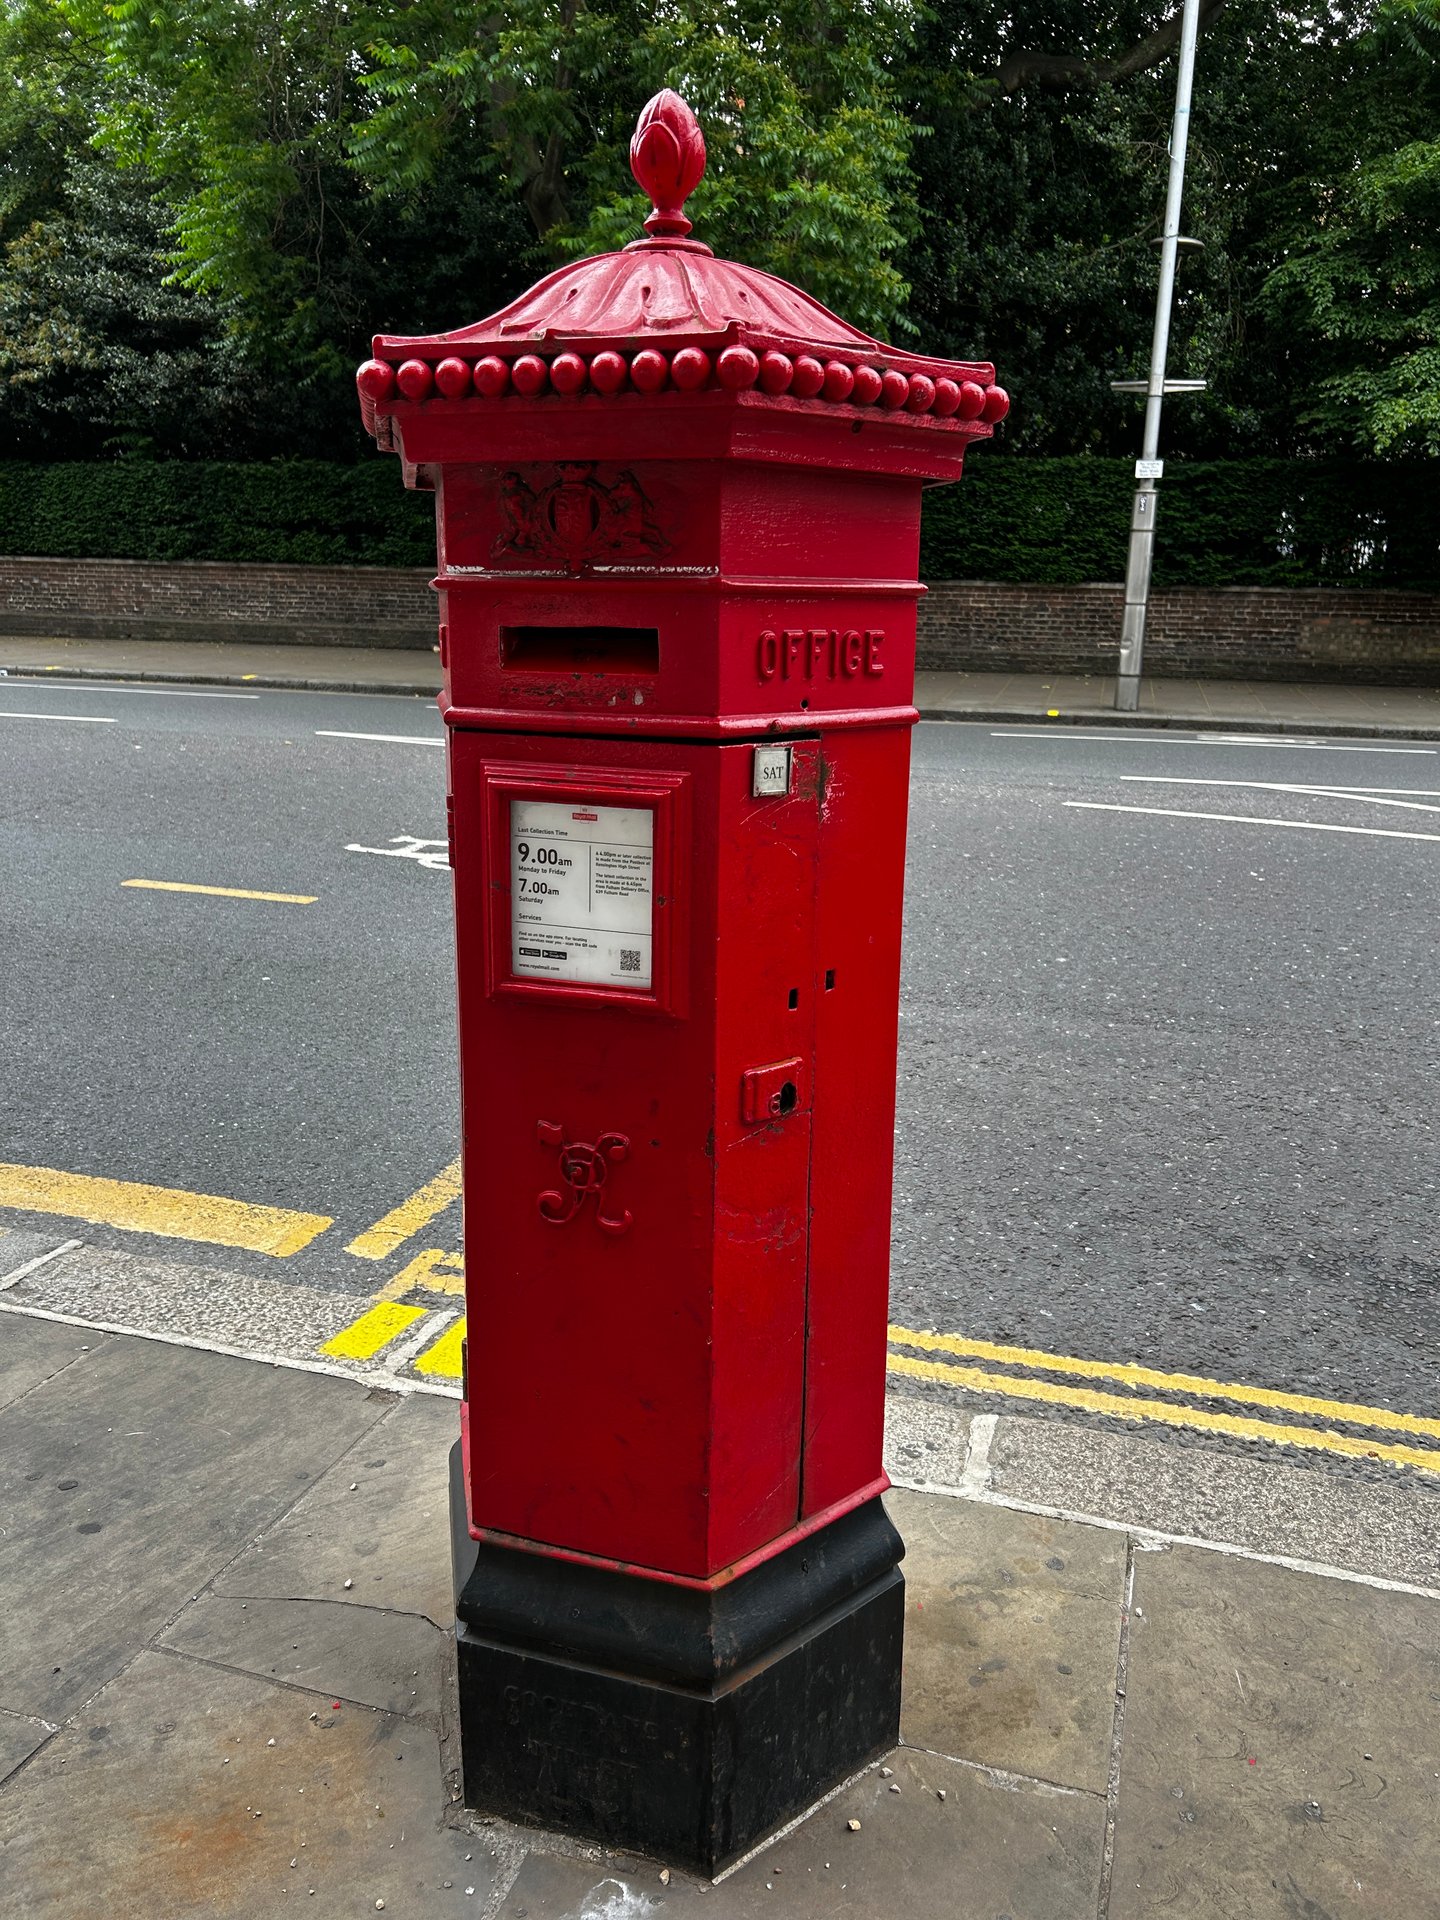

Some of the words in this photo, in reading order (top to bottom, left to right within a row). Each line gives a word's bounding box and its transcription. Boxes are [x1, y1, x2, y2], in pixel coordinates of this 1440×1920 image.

[758, 629, 886, 679] OFFICE
[764, 766, 784, 780] SAT
[518, 843, 572, 866] 9.00am
[519, 865, 540, 874] Monday
[549, 868, 566, 876] Friday
[519, 878, 559, 895] 7.00am
[519, 896, 543, 904] Saturday
